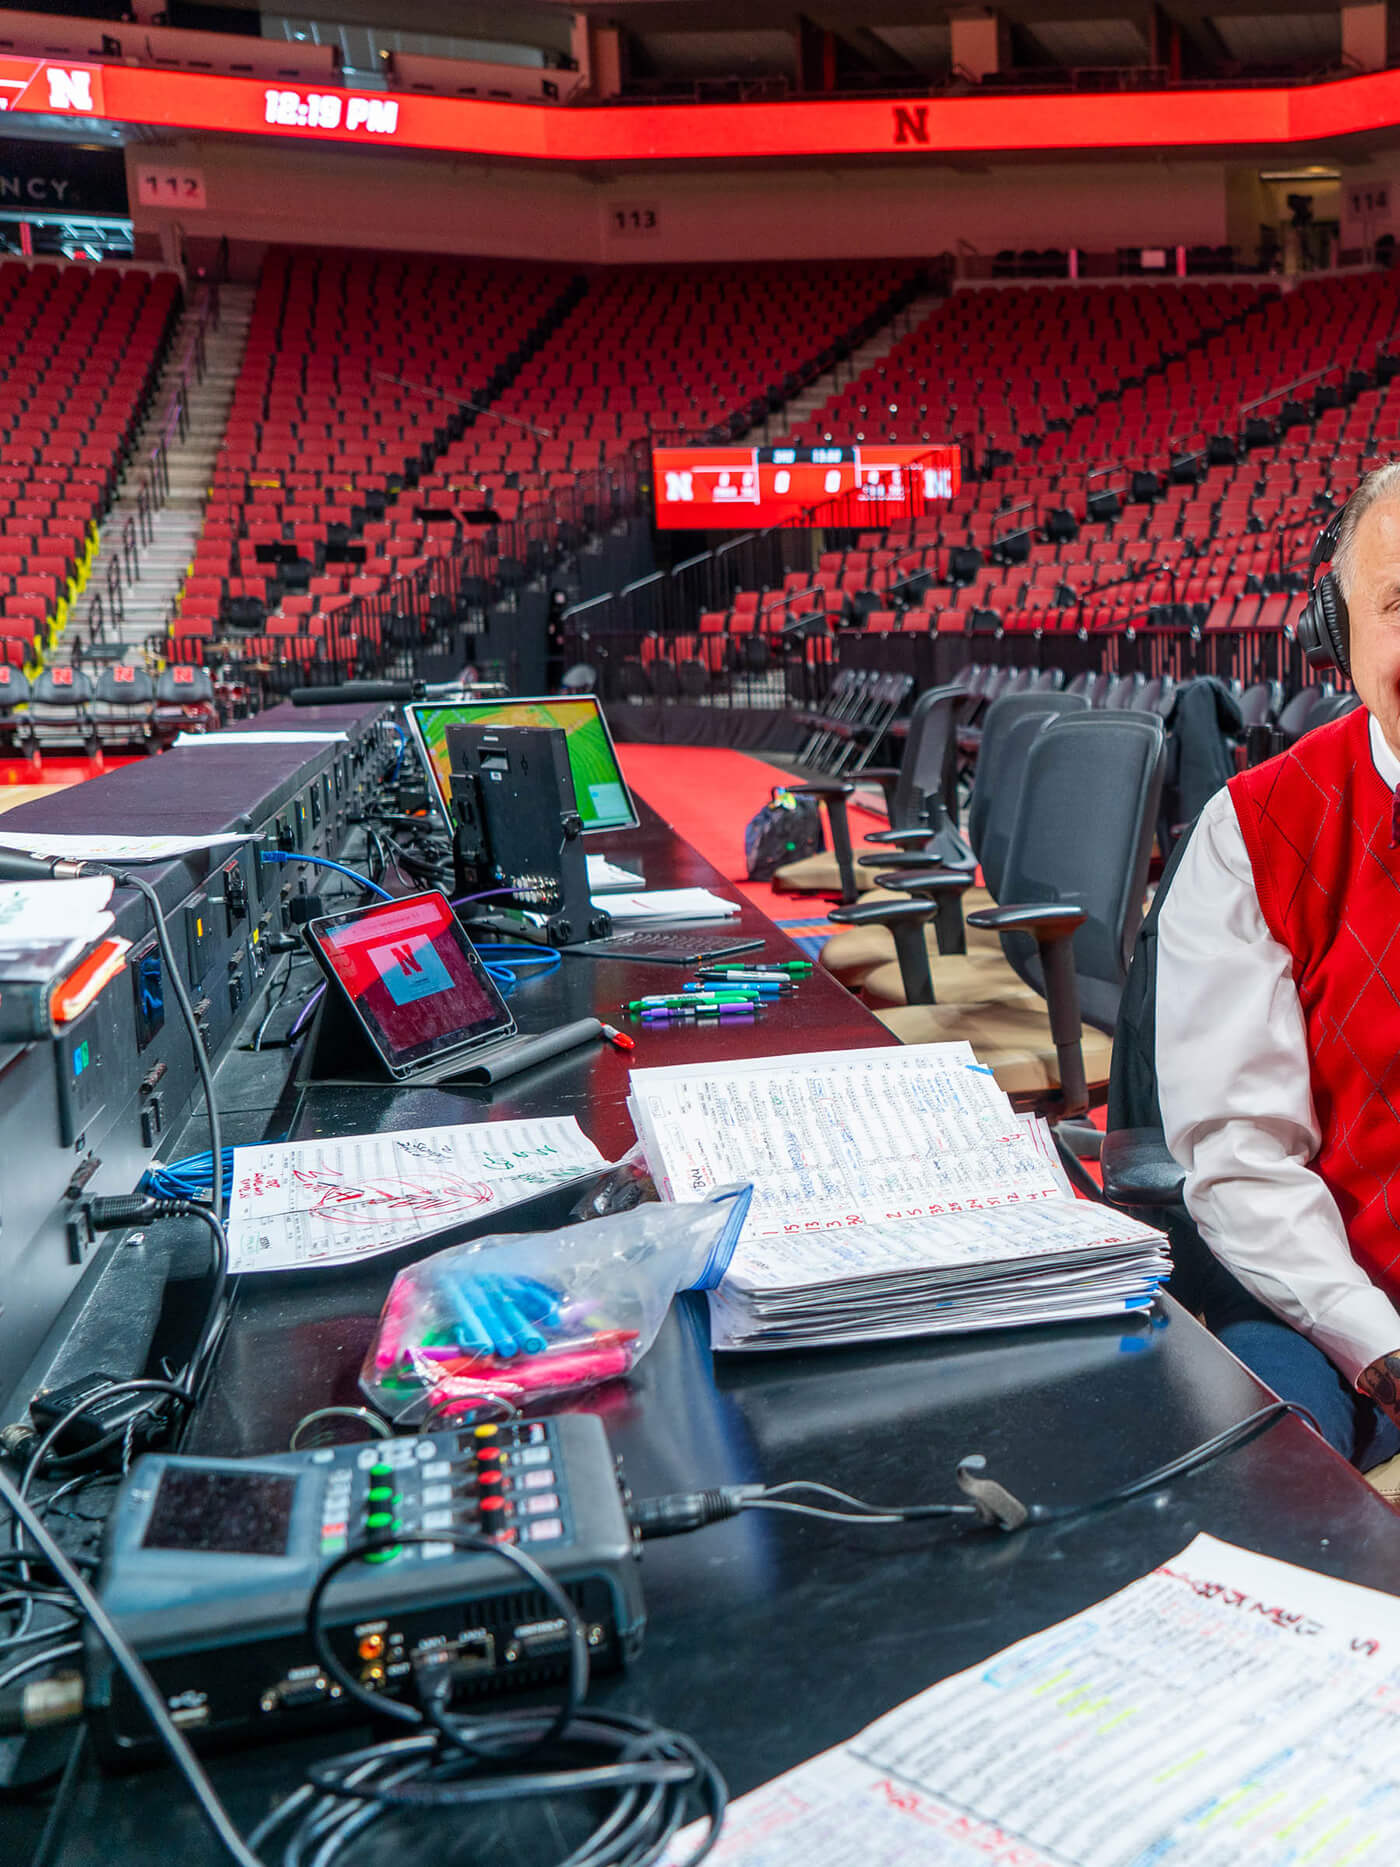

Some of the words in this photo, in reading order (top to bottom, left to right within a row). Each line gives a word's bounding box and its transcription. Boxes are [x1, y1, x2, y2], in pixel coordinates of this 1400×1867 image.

[46, 67, 93, 111] N
[346, 97, 399, 134] PM
[893, 107, 928, 144] N
[146, 175, 198, 199] 112
[615, 210, 657, 229] 113
[665, 471, 693, 501] N
[774, 469, 791, 494] 0
[824, 469, 841, 494] 0
[390, 943, 423, 976] N
